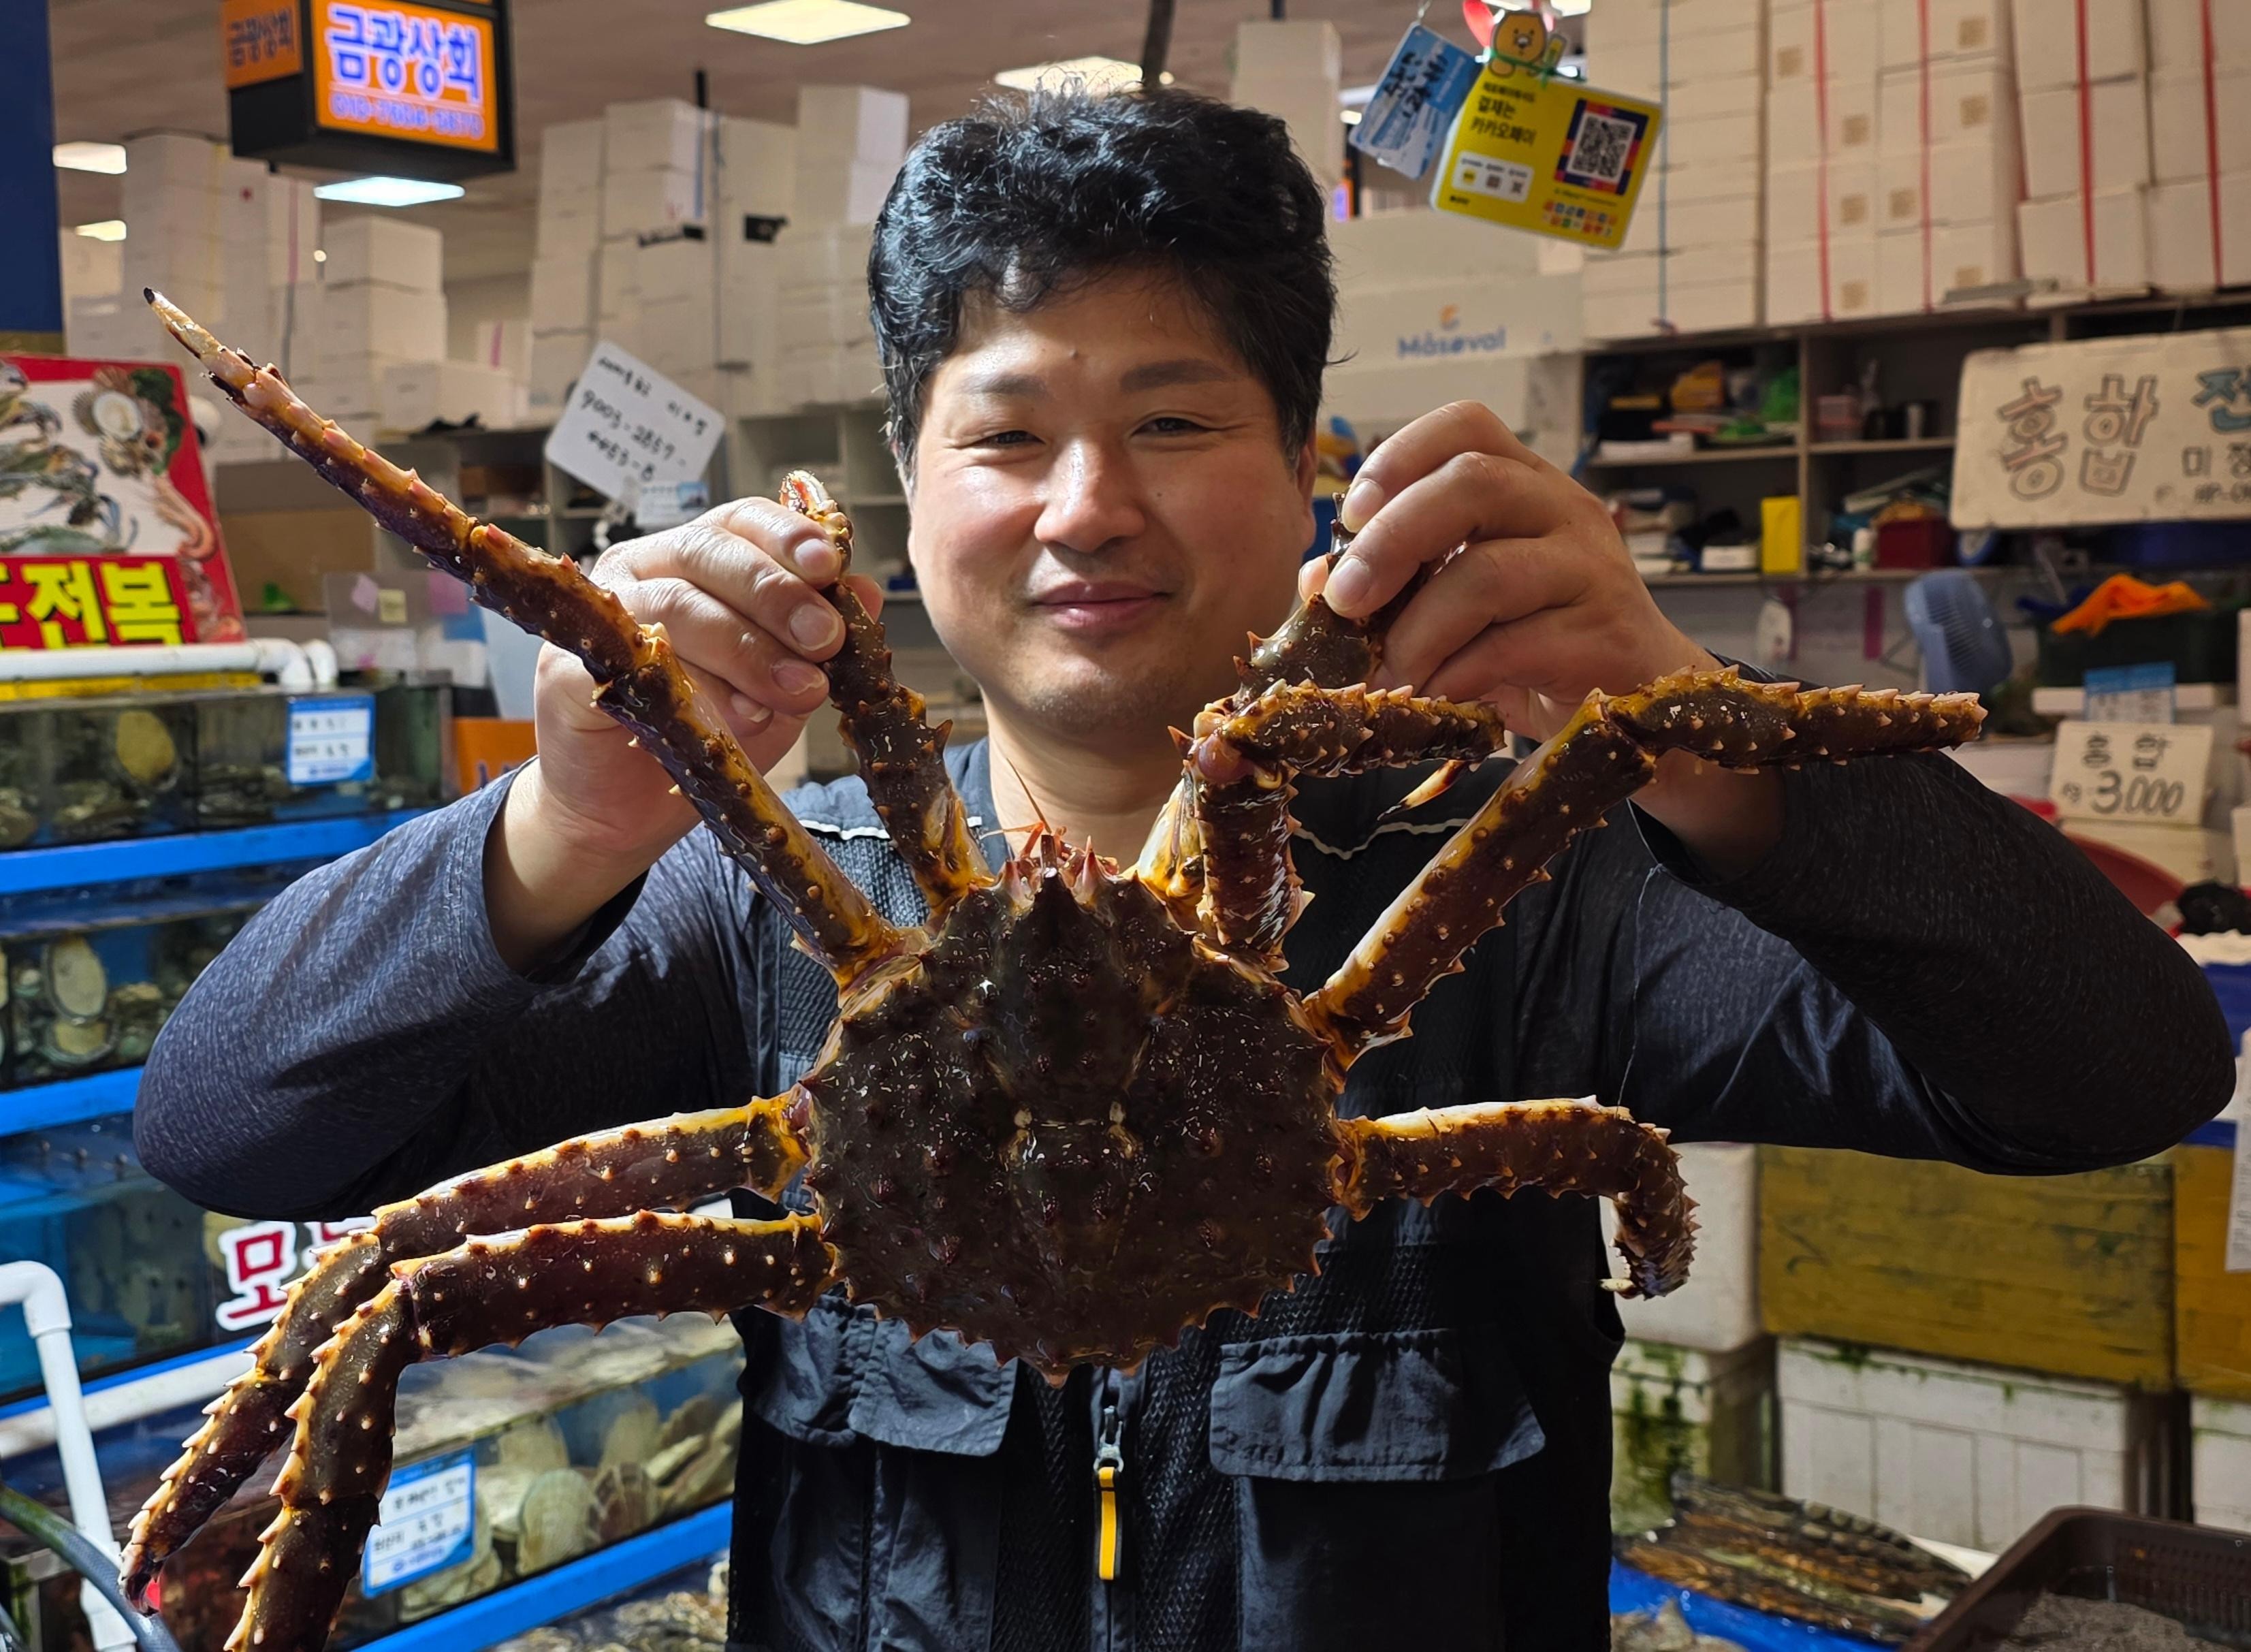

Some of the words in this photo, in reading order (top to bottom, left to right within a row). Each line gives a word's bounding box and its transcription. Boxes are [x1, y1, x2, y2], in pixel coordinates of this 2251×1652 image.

[330, 5, 482, 104] 금광상회
[1996, 372, 2160, 502] 홍합
[0, 560, 183, 650] 전복
